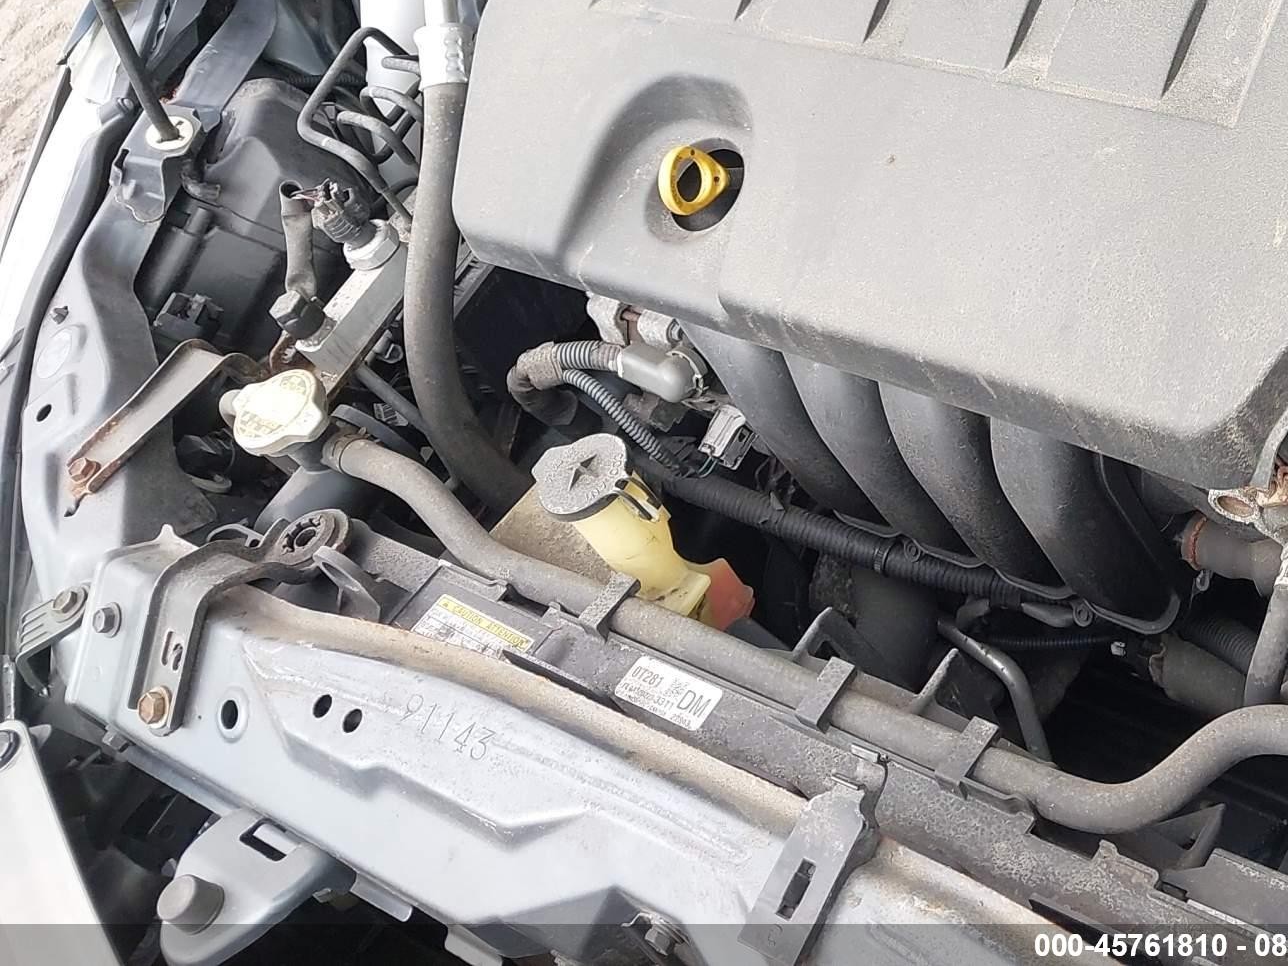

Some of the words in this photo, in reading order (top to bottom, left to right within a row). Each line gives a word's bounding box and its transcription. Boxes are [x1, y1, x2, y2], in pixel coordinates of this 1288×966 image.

[452, 604, 482, 623] CAUTION
[485, 620, 526, 646] ATTENTION
[677, 690, 711, 718] DM
[400, 694, 496, 759] 91143
